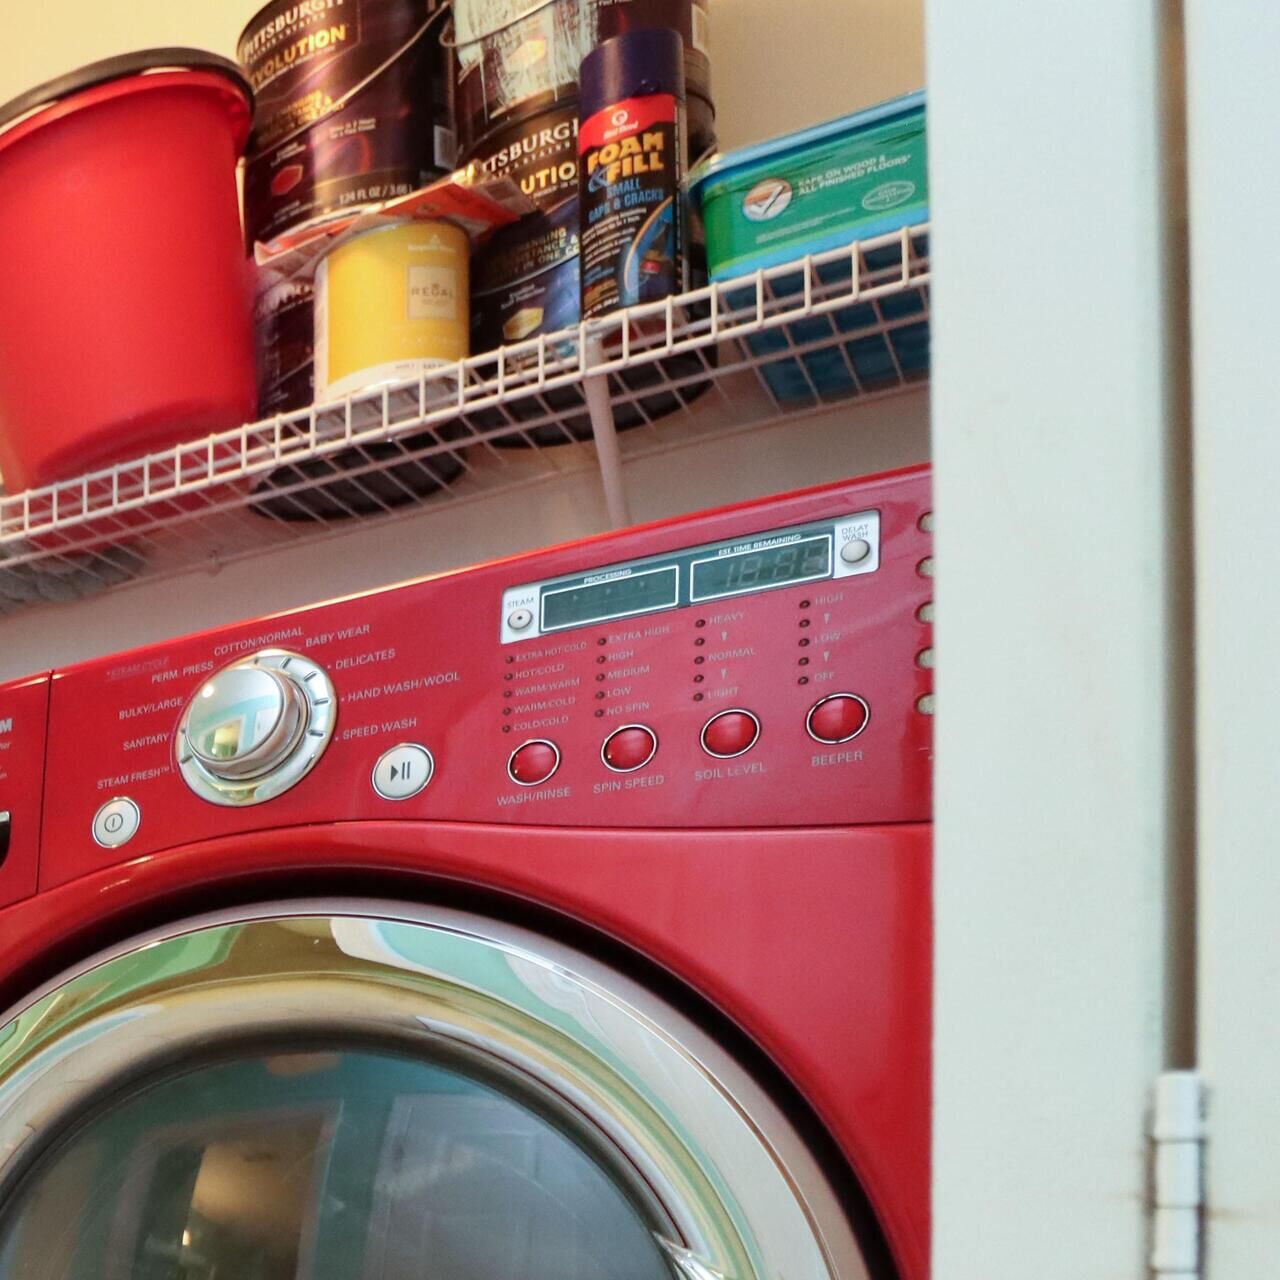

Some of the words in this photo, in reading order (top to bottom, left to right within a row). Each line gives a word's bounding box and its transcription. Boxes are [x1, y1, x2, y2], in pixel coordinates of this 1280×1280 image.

[481, 117, 579, 173] TTSBURG
[587, 131, 664, 176] FOAM
[606, 152, 664, 184] FILL
[607, 178, 640, 198] SMALL
[624, 188, 665, 207] CRACKS
[753, 534, 802, 550] REMAINING
[583, 568, 632, 585] PROCESSING
[709, 611, 745, 625] HEAVY
[214, 627, 304, 657] COTTON/NORMAL
[305, 632, 334, 647] BABY
[337, 624, 371, 640] WEAR
[609, 632, 641, 644] EXTRA
[335, 648, 396, 670] DELICATES
[608, 649, 634, 662] HIGH
[708, 648, 756, 662] NORMAL
[182, 661, 214, 677] PRESS
[515, 664, 565, 680] HOT/COLD
[607, 665, 650, 680] MEDIUM
[348, 687, 381, 702] HAND
[383, 672, 460, 695] WASH/WOOL
[514, 678, 580, 697] WARM/WARM
[606, 687, 632, 698] LOW
[118, 696, 184, 720] BULKY/LARGE
[513, 697, 576, 714] WARM/COLD
[606, 706, 623, 716] NO
[625, 701, 650, 713] SPIN
[343, 725, 378, 741] SPEED
[381, 718, 417, 733] WASH
[513, 716, 569, 732] COLD/COLD
[123, 733, 169, 751] SANITARY
[811, 751, 864, 767] BEEPER
[694, 768, 724, 781] SOIL
[727, 762, 767, 777] LEVEL
[96, 775, 129, 789] STEAM
[592, 782, 622, 794] SPIN
[625, 775, 665, 789] SPEED
[496, 787, 571, 807] WASH/RINSE
